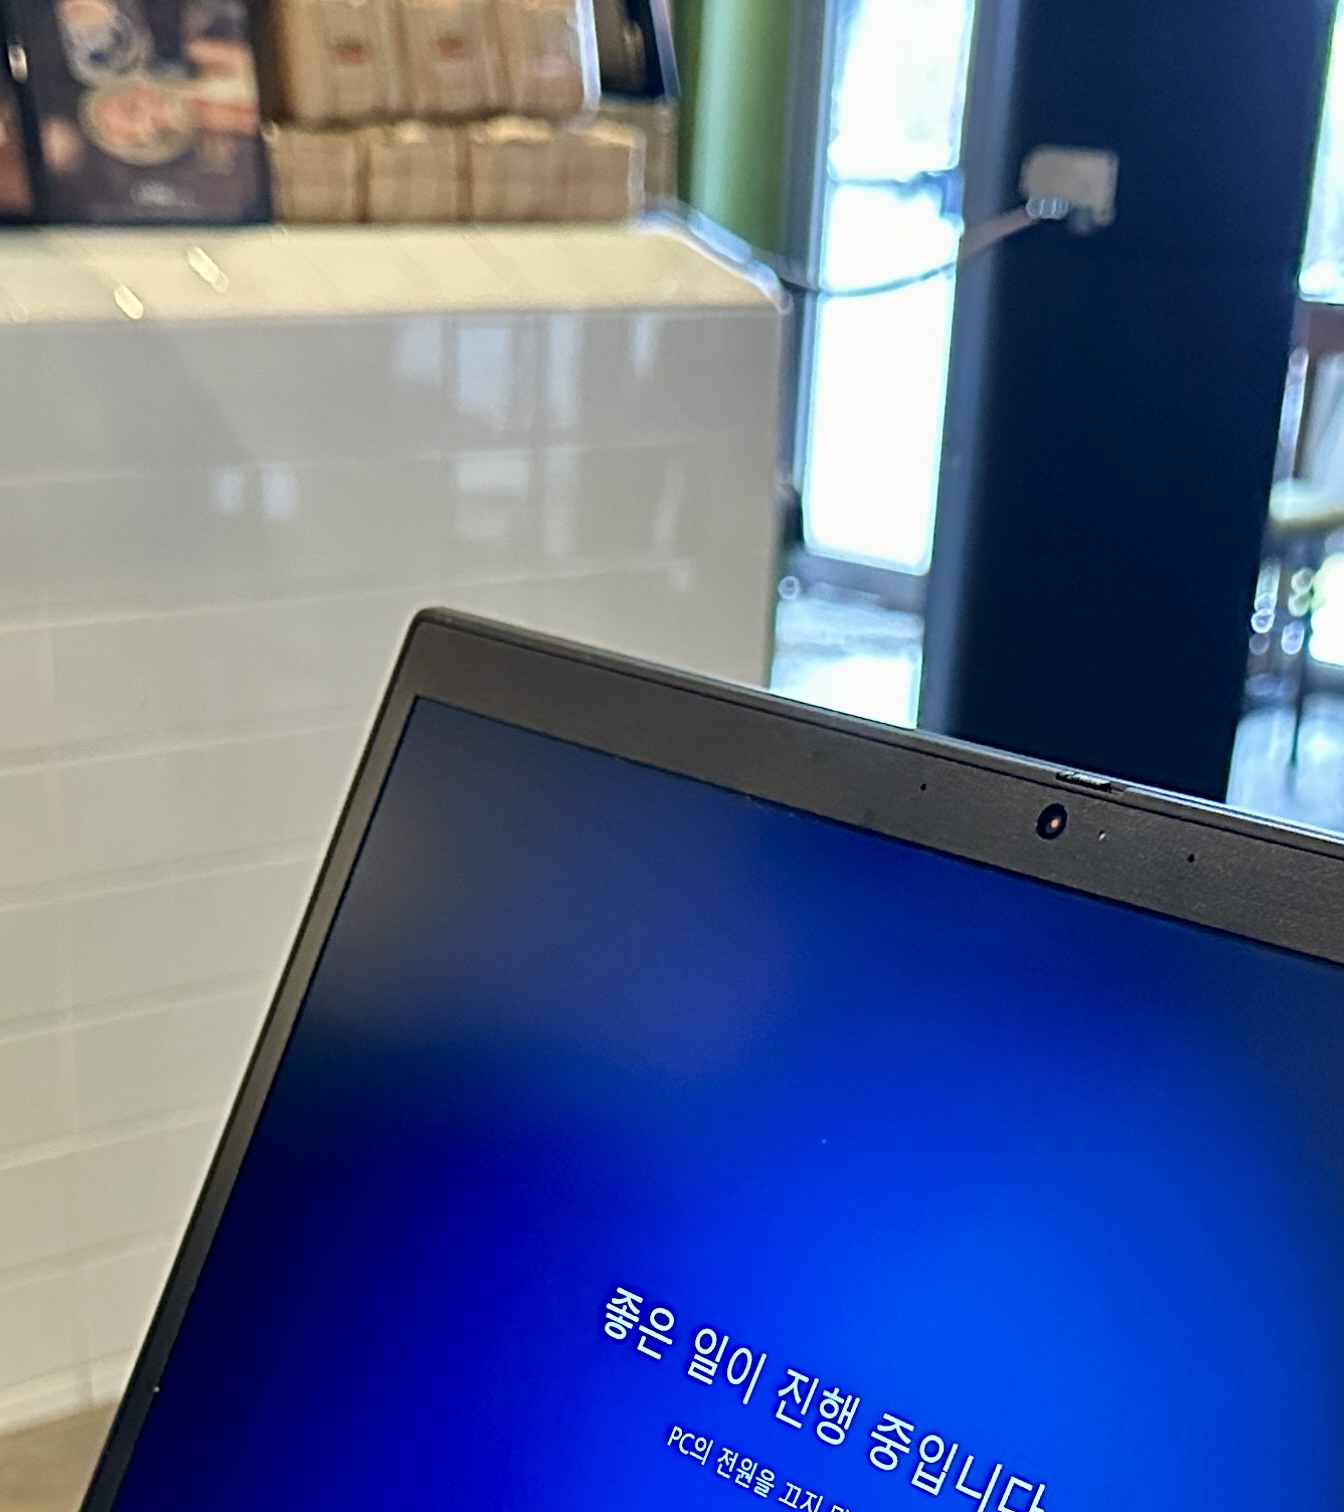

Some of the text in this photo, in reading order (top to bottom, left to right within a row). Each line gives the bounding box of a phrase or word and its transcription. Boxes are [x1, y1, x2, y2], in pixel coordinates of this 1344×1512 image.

[605, 1288, 674, 1359] 좋은
[688, 1328, 766, 1404] 일이
[776, 1369, 860, 1445] 진행
[668, 1426, 713, 1465] PC의
[717, 1448, 774, 1498] 전원을
